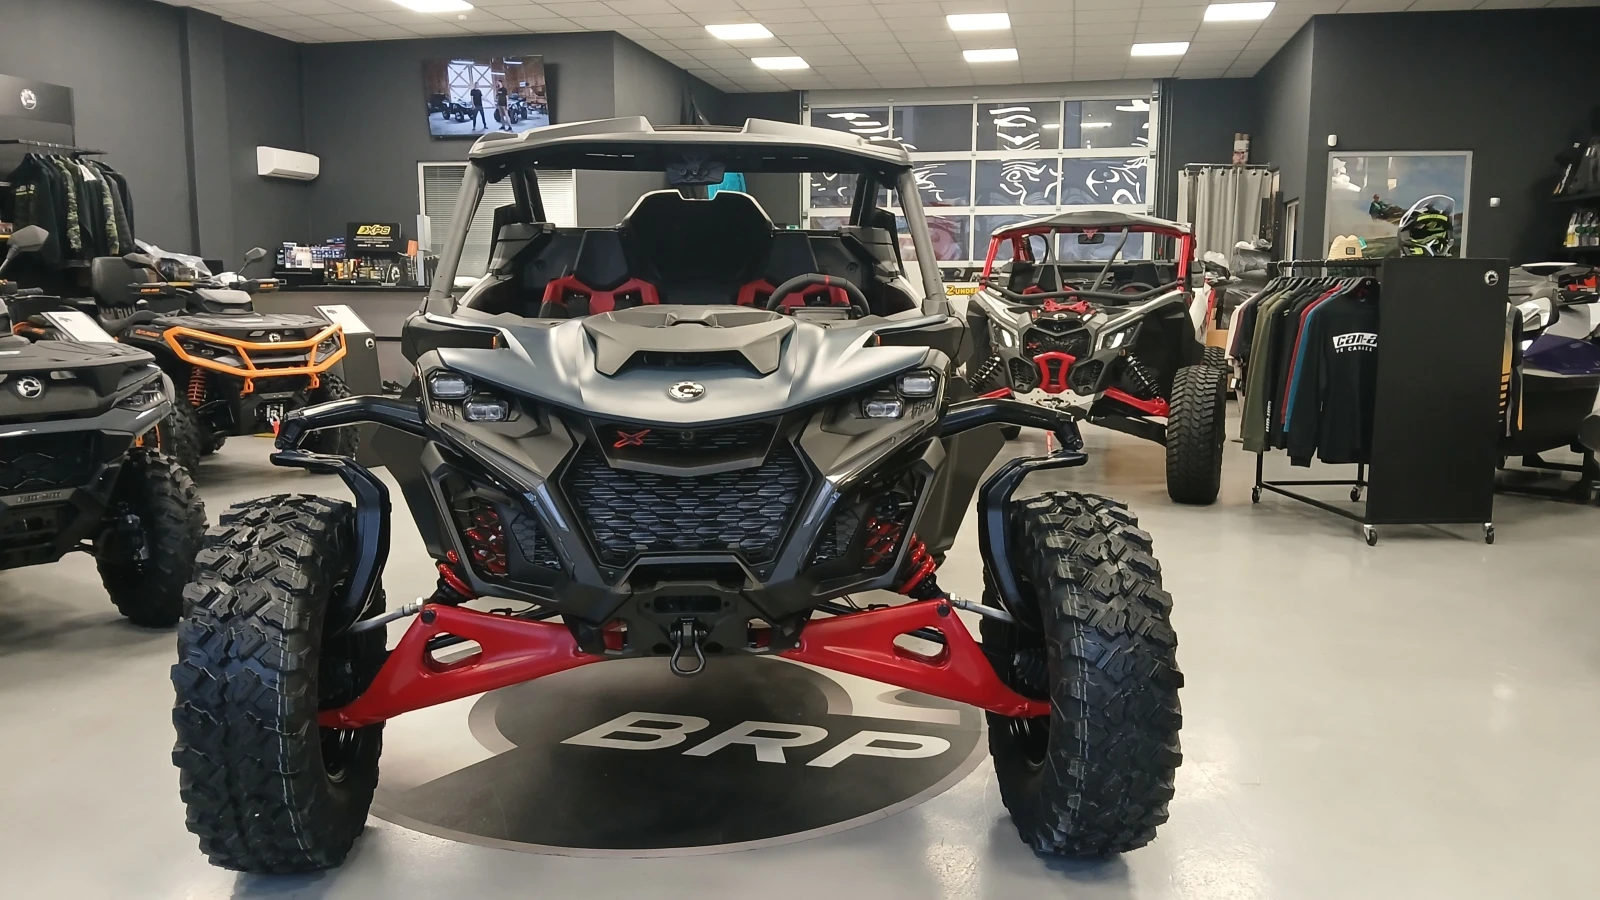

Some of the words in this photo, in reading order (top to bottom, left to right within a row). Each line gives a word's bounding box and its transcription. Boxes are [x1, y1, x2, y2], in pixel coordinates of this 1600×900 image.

[361, 225, 391, 235] XPS
[946, 285, 978, 296] ZUNDE
[560, 711, 951, 767] BRP
